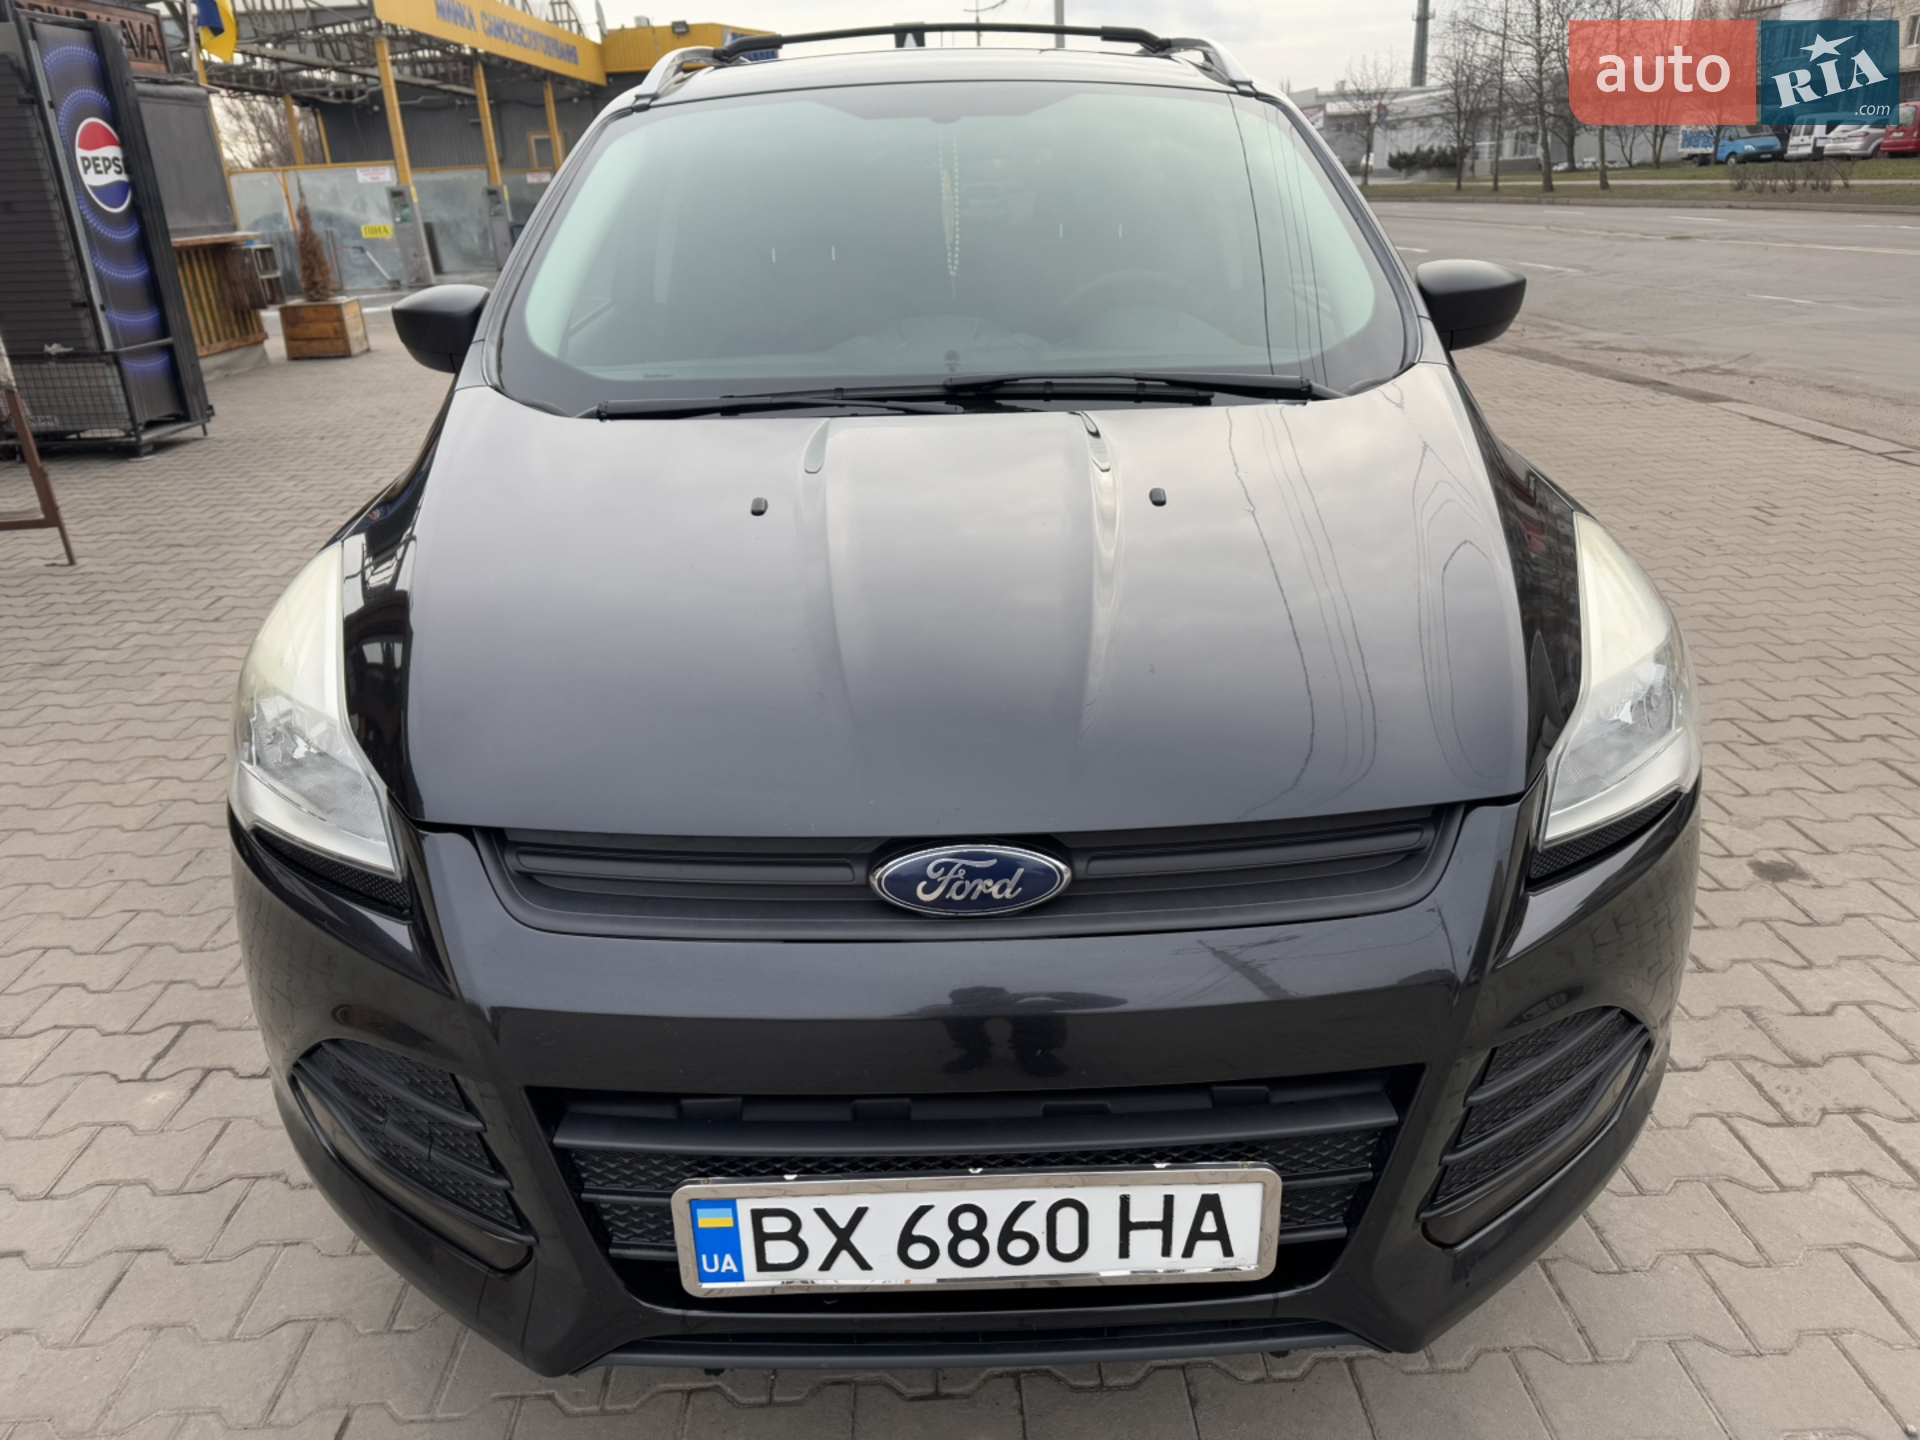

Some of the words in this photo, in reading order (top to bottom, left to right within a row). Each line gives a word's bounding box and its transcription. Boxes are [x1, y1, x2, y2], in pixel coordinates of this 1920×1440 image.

[916, 858, 1024, 902] Ford
[750, 1206, 874, 1272] BX
[897, 1198, 1089, 1270] 6860
[1119, 1192, 1235, 1259] HA
[702, 1253, 738, 1273] UA
